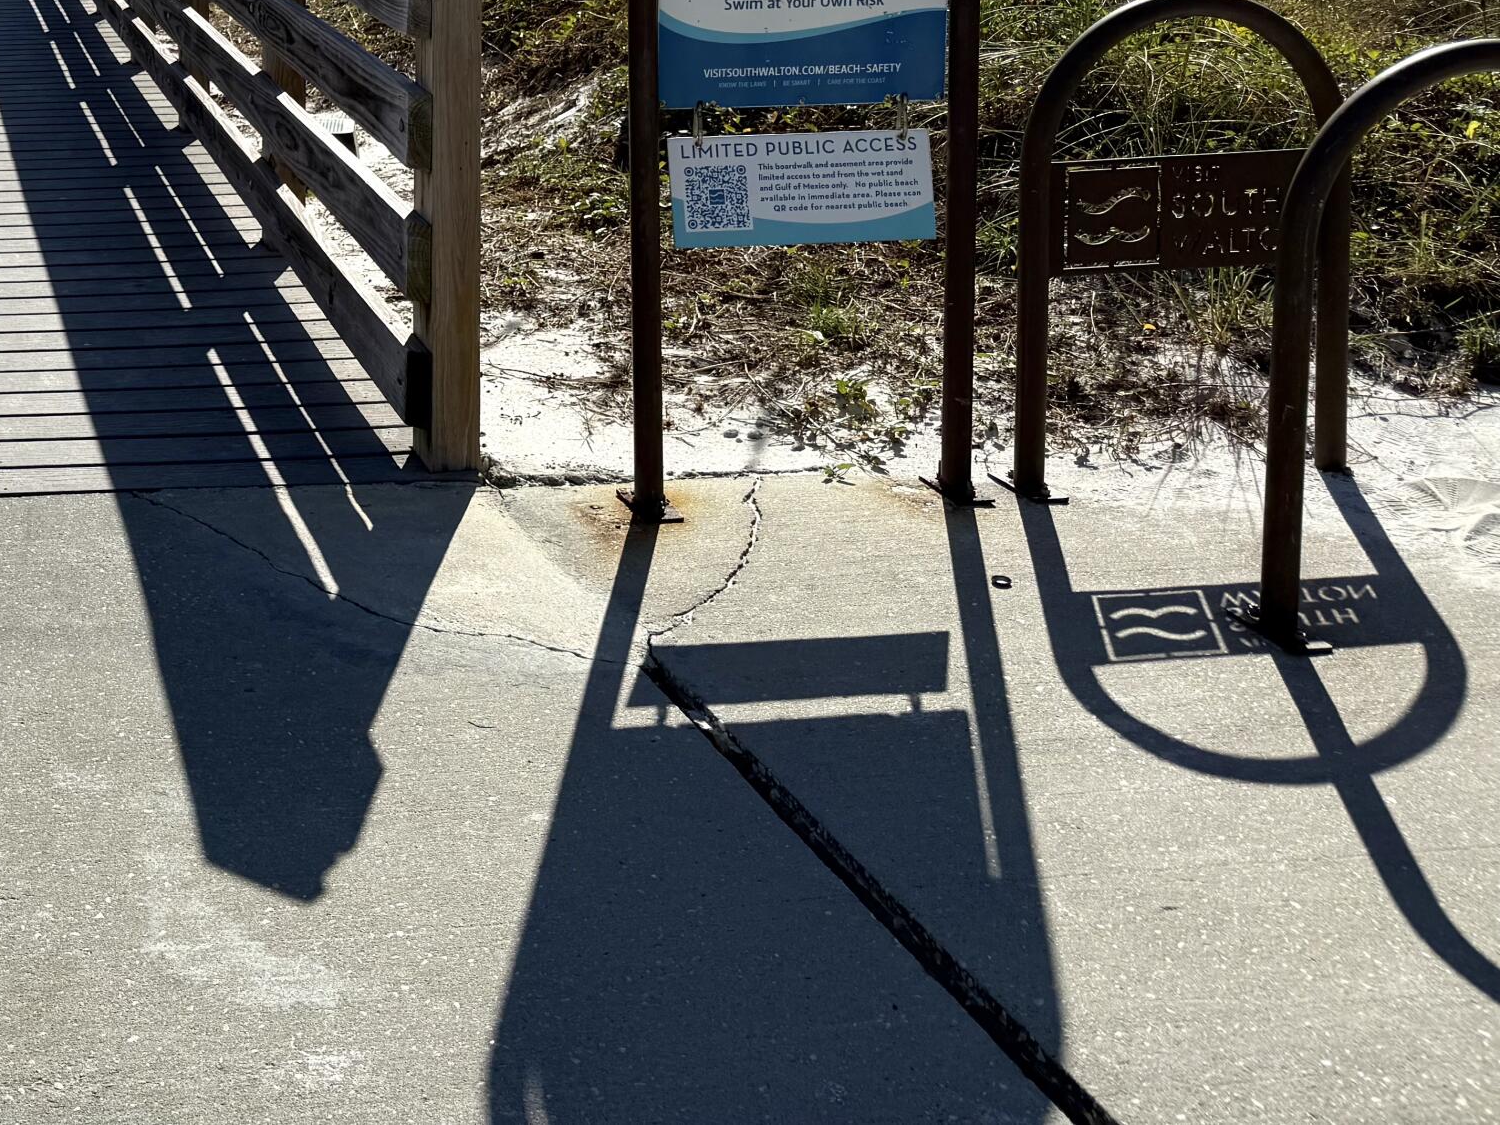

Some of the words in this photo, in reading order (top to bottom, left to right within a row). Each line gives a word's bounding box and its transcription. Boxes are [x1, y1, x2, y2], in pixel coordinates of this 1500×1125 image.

[704, 62, 901, 78] VISITSOUTHWALTON.COM/BEACH-SAFETY
[681, 143, 758, 159] LIMITED
[766, 140, 835, 156] PUBLIC
[842, 137, 917, 153] ACCESS
[775, 161, 813, 170] boardwalk
[886, 158, 913, 167] provide
[832, 181, 848, 190] only.
[869, 180, 893, 188] public
[858, 201, 882, 210] public
[1171, 188, 1279, 218] SOUTH
